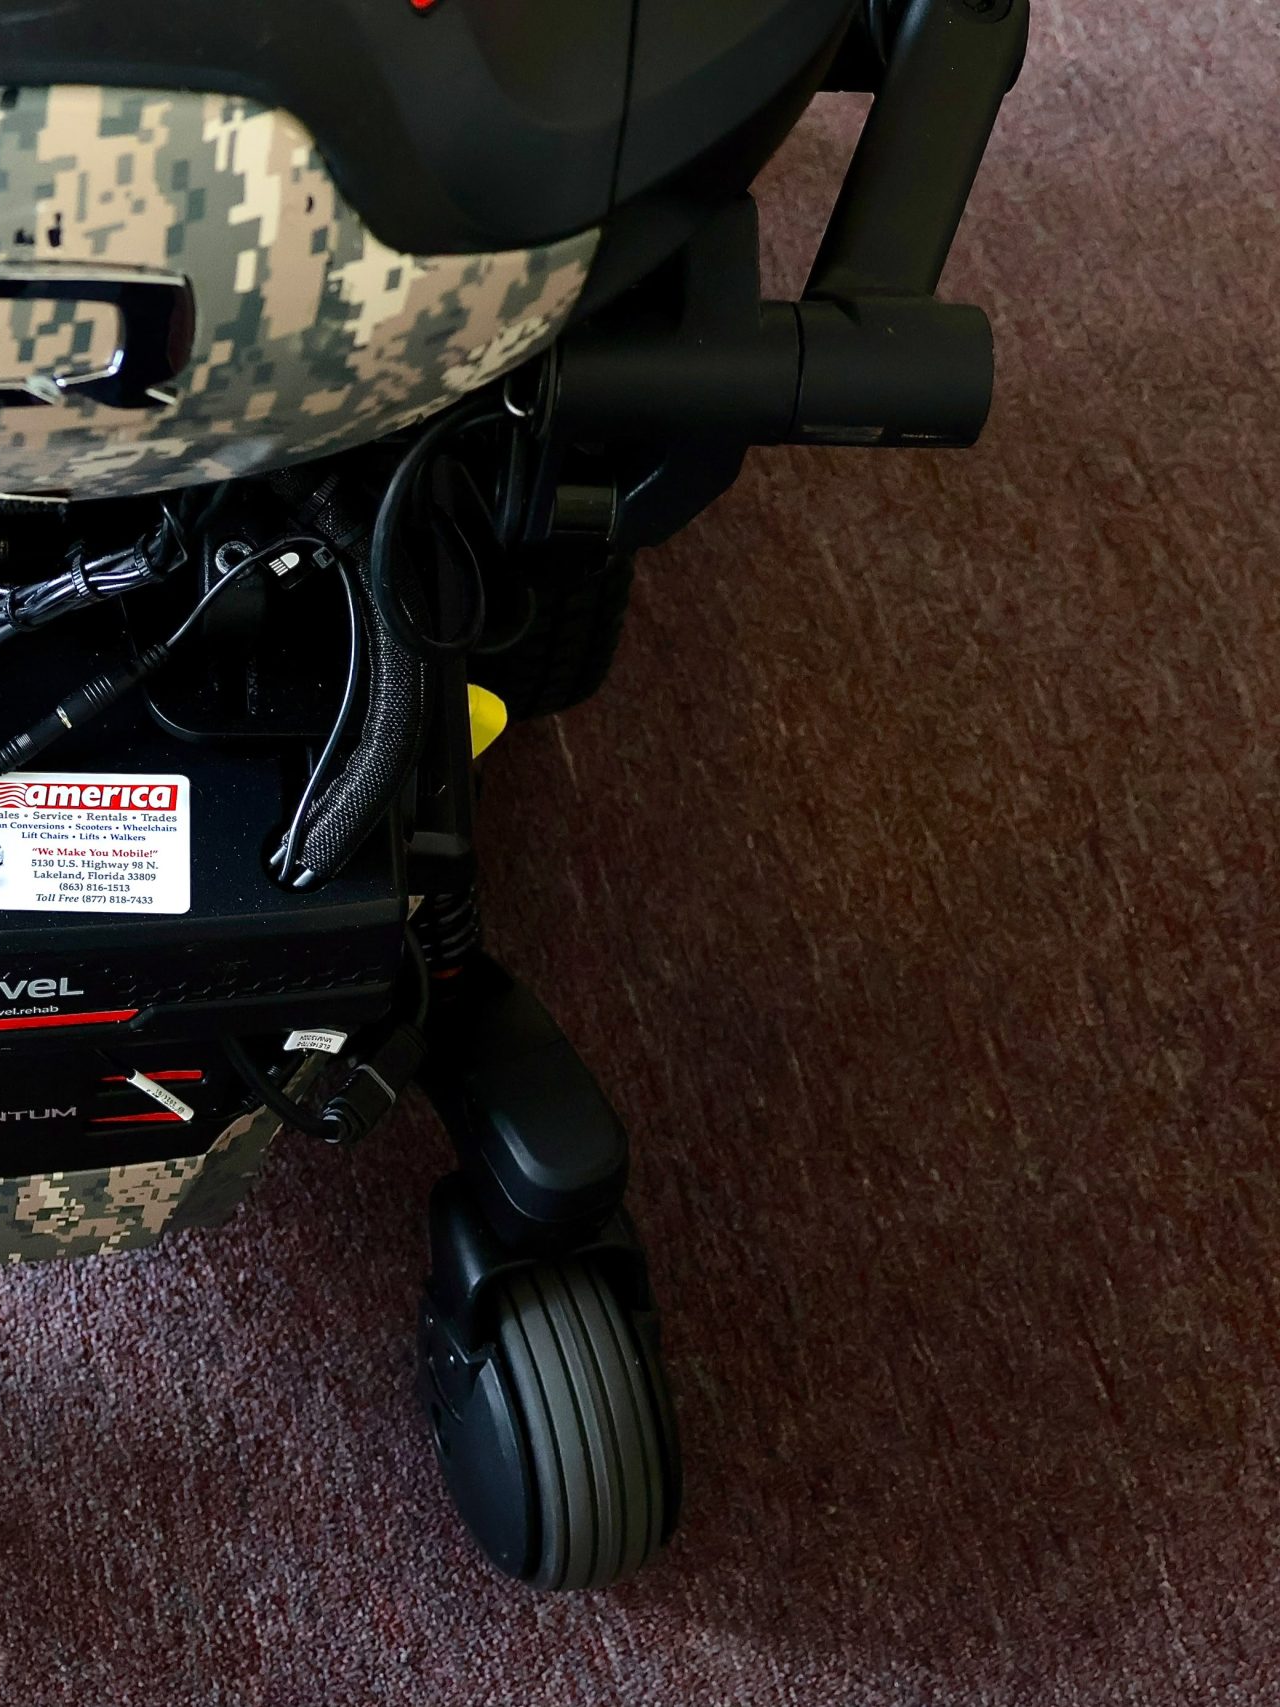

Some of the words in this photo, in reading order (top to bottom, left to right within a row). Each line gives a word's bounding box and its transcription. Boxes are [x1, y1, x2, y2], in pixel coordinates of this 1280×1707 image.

[25, 784, 171, 808] america
[33, 811, 73, 821] Service
[86, 812, 128, 822] Rentals
[141, 813, 177, 822] Trades
[10, 822, 65, 831] Conversions
[75, 823, 112, 831] Scooters
[123, 824, 177, 832] Wheelchairs
[22, 832, 40, 840] Lift
[41, 832, 69, 840] Chairs
[79, 833, 100, 841] Lifts
[110, 833, 146, 841] Walkers
[56, 848, 86, 857] Make
[89, 848, 109, 857] You
[31, 859, 55, 867] 5130
[57, 859, 79, 868] U.S.
[81, 860, 130, 871] Highway
[132, 861, 144, 870] 98
[146, 861, 159, 870] N.
[33, 871, 85, 881] Lakeland,
[87, 872, 125, 881] Florida
[127, 873, 157, 881] 33809
[59, 882, 84, 892] (863)
[86, 883, 130, 892] 816-1513
[36, 894, 56, 902] Toll
[58, 894, 80, 903] Free
[82, 894, 107, 904] (877)
[109, 895, 154, 904] 818-7433
